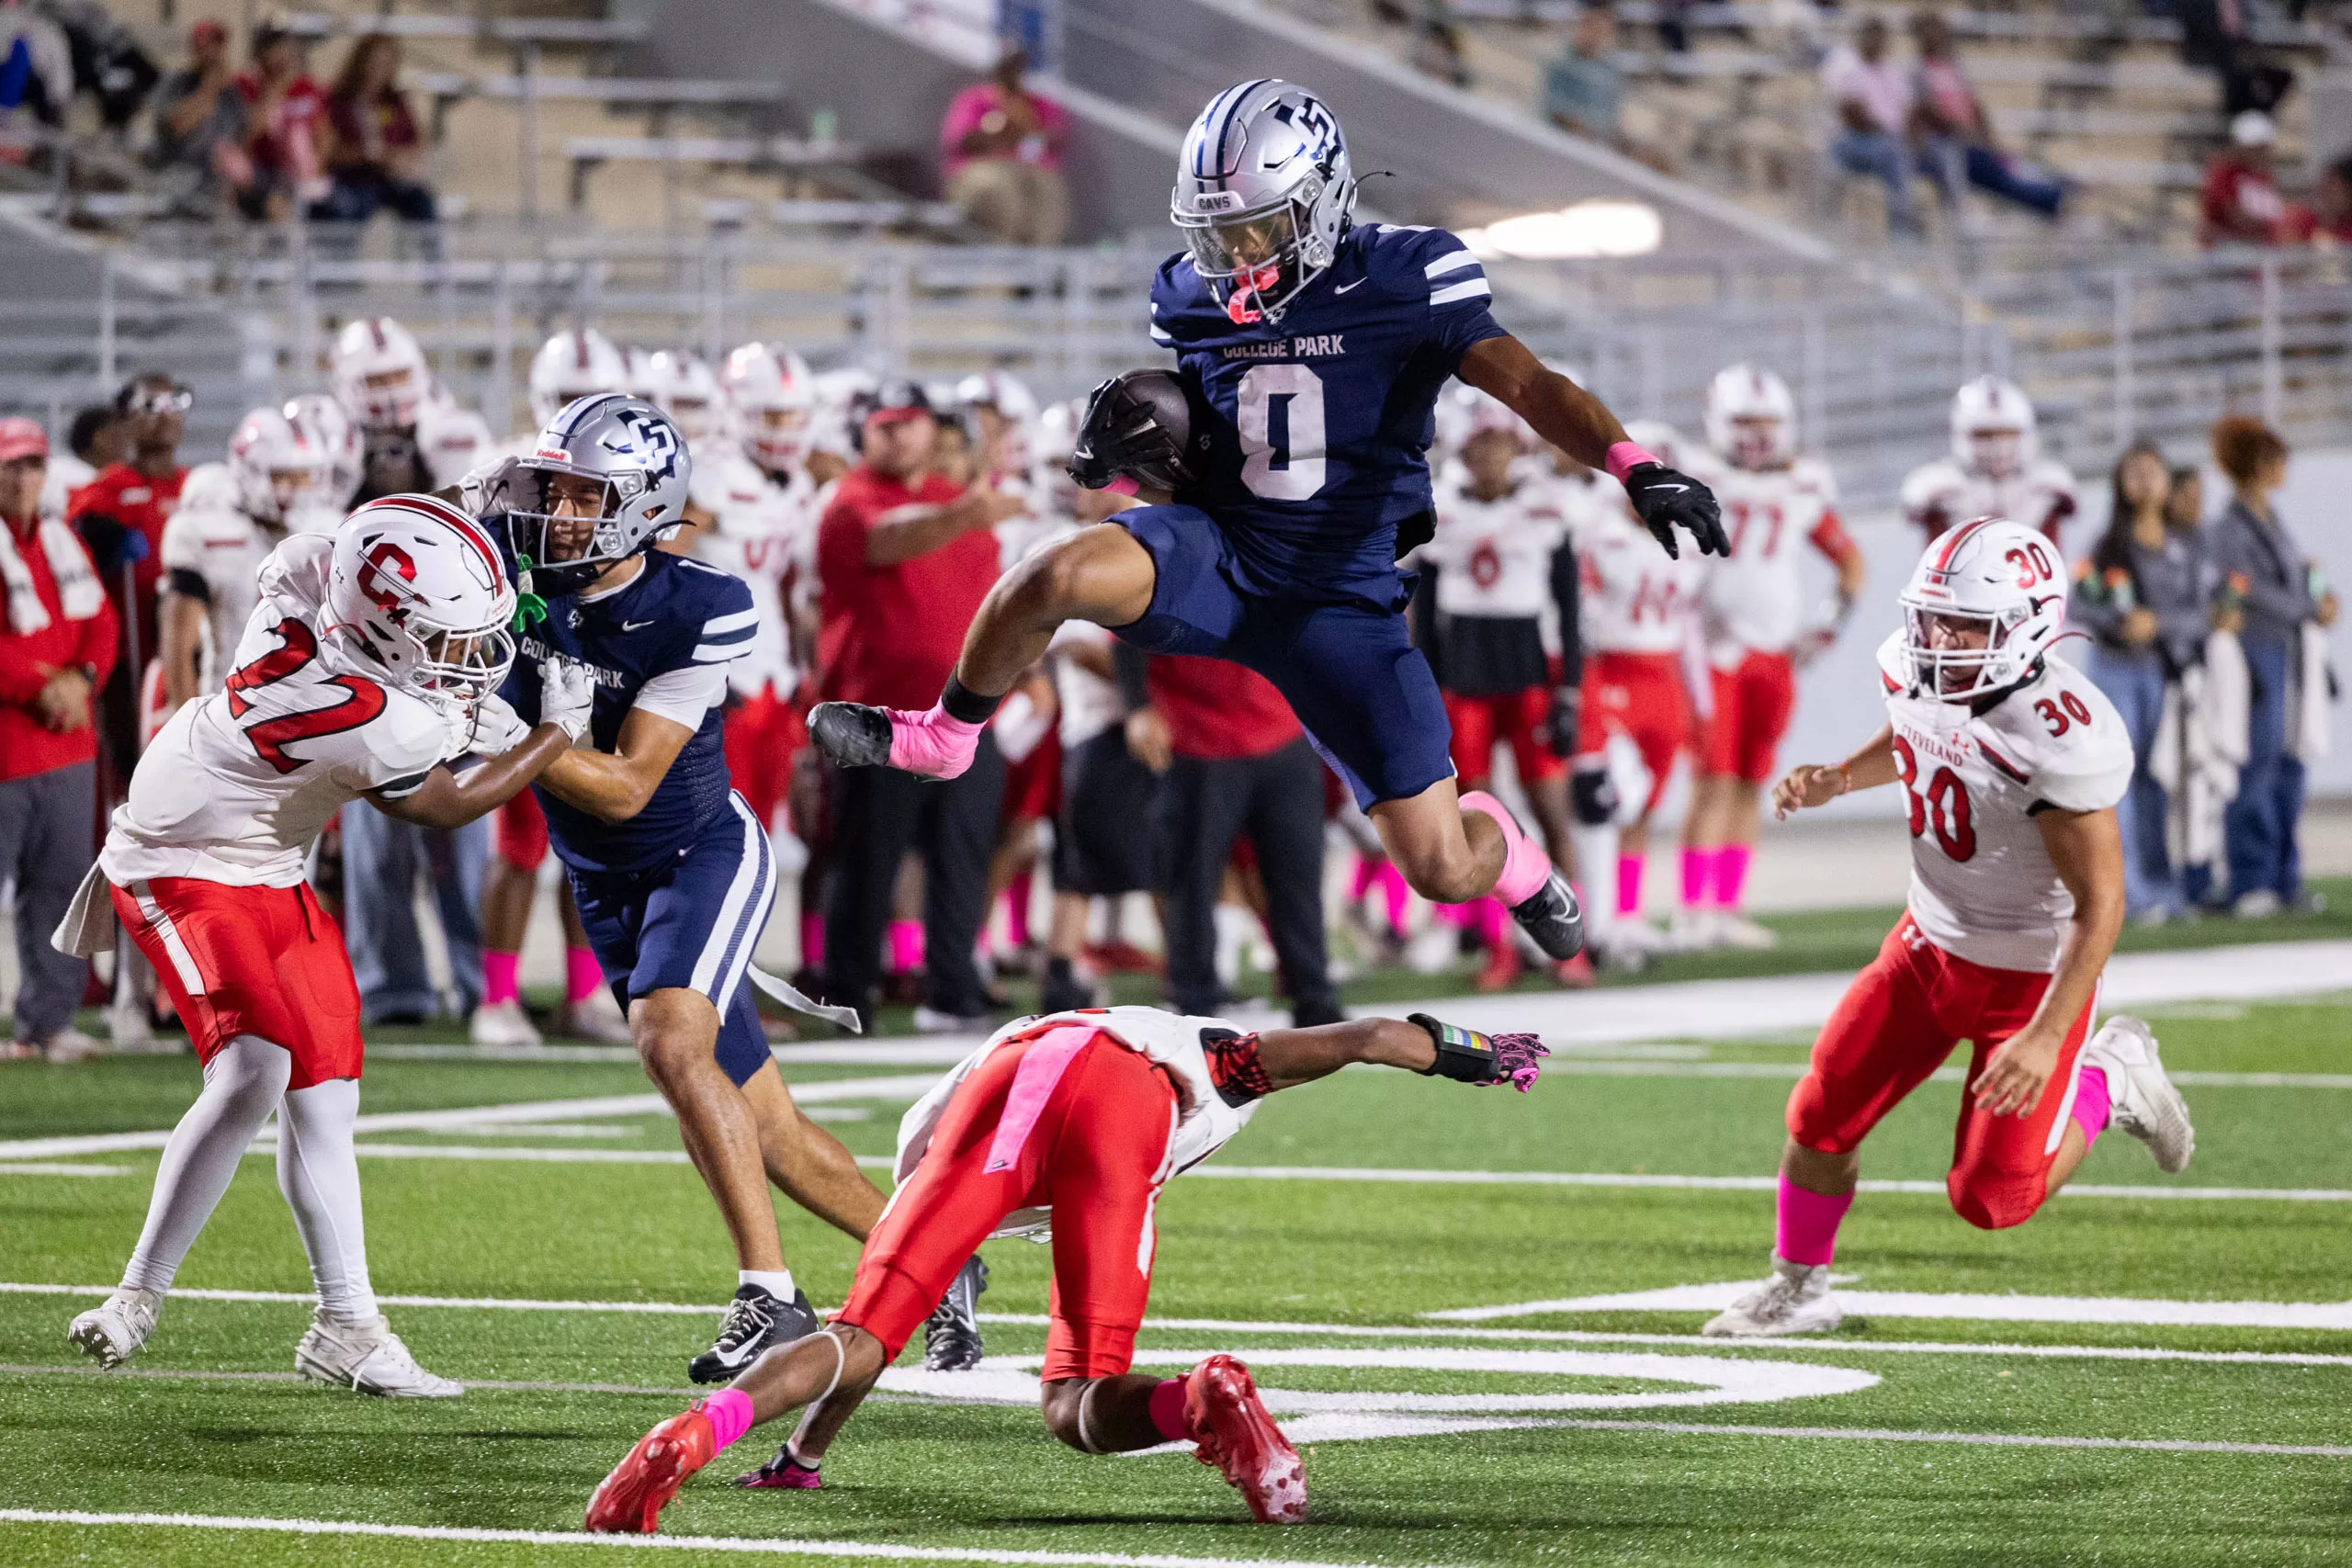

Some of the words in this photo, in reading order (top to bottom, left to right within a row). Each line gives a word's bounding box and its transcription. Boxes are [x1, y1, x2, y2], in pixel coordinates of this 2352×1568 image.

[1198, 196, 1230, 210] CAVS
[1294, 334, 1345, 356] PARK
[536, 448, 566, 460] Riddell
[2005, 542, 2052, 590] 30
[583, 662, 625, 688] PARK
[2033, 691, 2091, 738] 30
